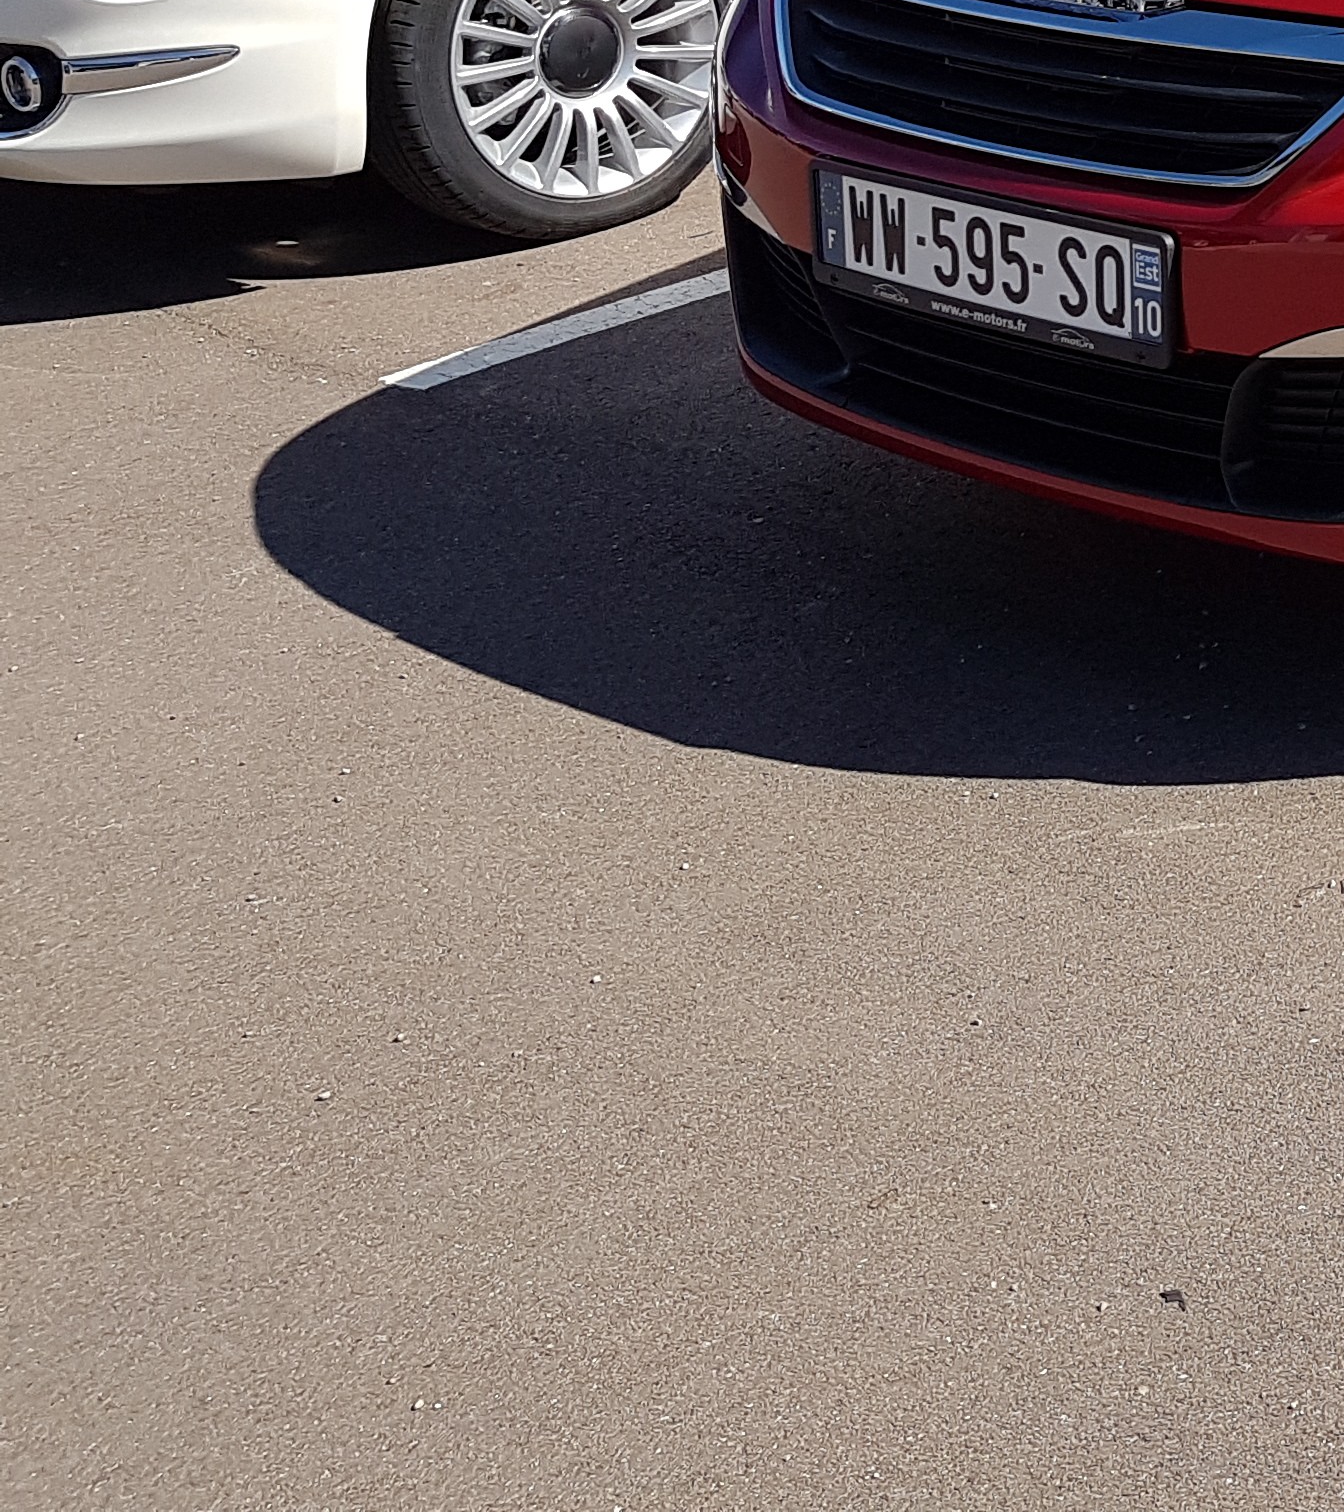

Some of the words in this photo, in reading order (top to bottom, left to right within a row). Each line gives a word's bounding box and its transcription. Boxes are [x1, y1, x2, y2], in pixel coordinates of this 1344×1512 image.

[827, 228, 837, 249] F
[1134, 251, 1160, 265] Grand
[1134, 262, 1160, 282] Est
[930, 300, 1028, 333] www.e-motors.fr
[1133, 297, 1162, 337] 10
